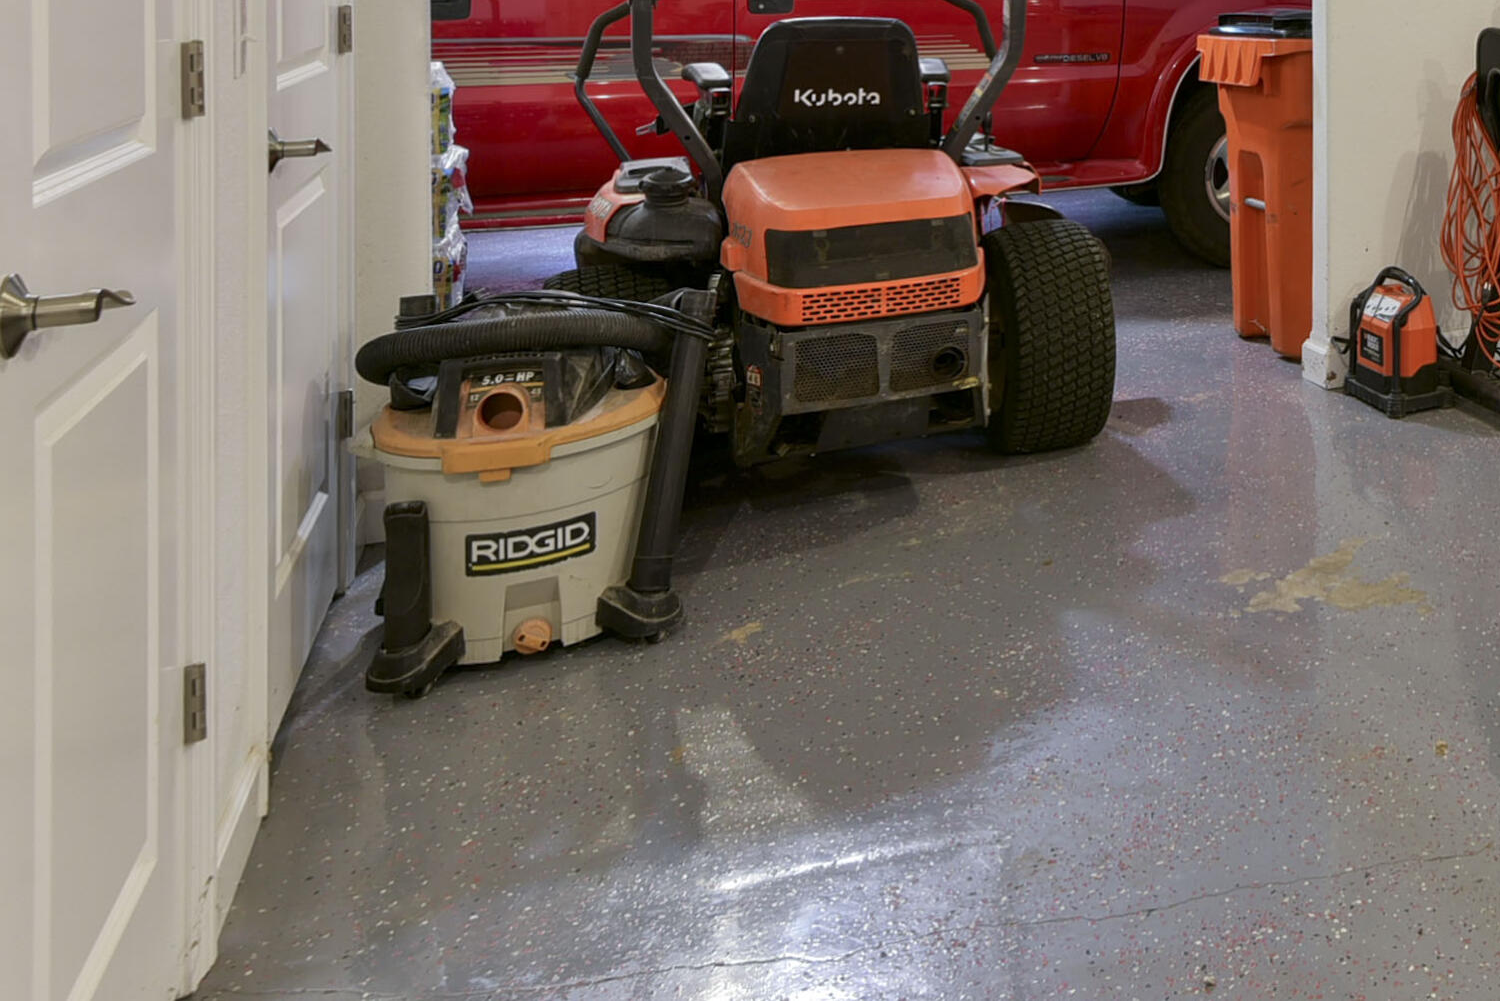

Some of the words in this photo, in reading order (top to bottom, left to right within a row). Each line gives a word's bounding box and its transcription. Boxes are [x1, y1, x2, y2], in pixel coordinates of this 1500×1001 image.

[794, 87, 881, 107] Kubota
[516, 371, 535, 383] HP
[471, 521, 590, 563] RIDGID
